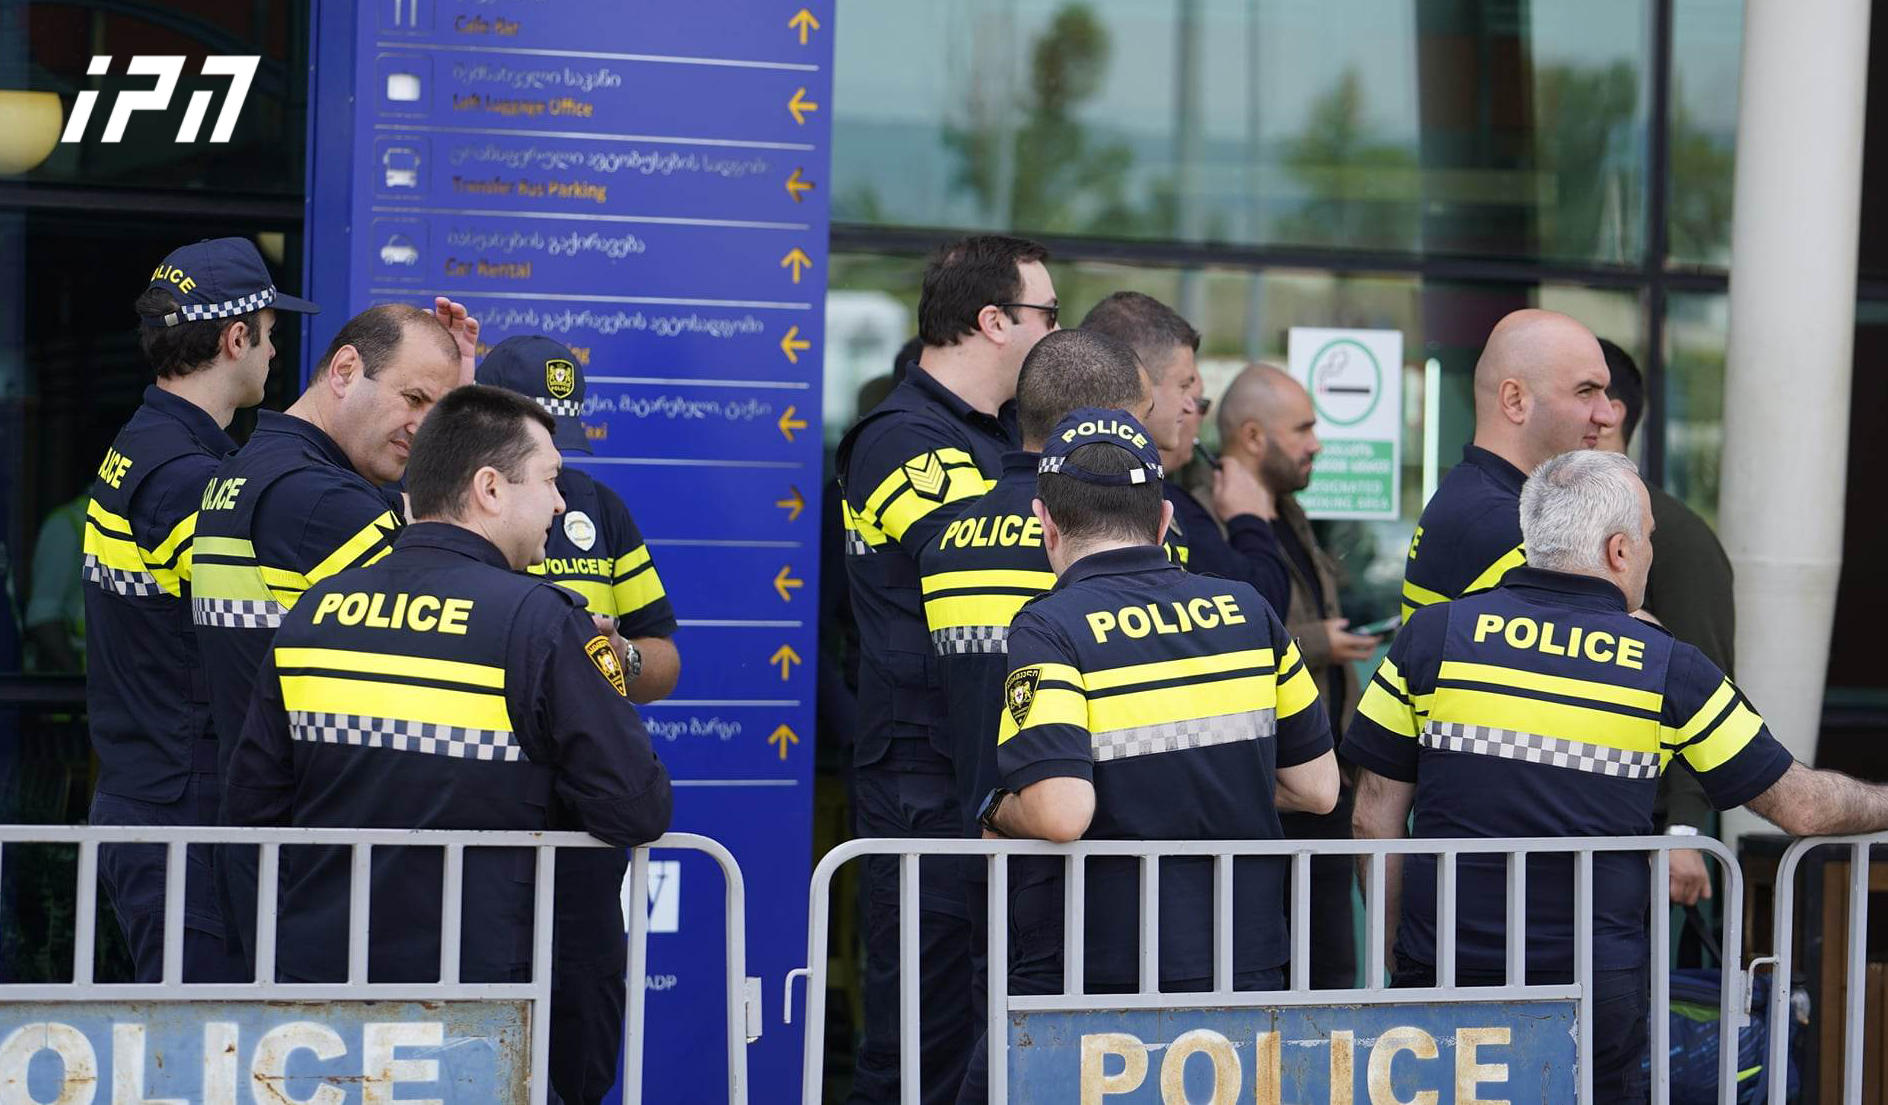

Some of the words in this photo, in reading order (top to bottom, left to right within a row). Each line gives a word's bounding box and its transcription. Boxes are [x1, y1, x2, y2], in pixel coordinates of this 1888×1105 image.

[549, 97, 594, 118] Office
[518, 178, 546, 198] Bus
[549, 180, 607, 204] Parking
[444, 257, 472, 277] Car
[477, 258, 533, 280] Rental
[582, 421, 608, 440] axi
[1061, 419, 1148, 449] POLICE
[940, 515, 1043, 550] POLICE
[312, 592, 474, 635] POLICE
[1085, 594, 1247, 644] POLICE
[1473, 613, 1646, 671] POLICE
[1080, 1026, 1511, 1105] POLICE
